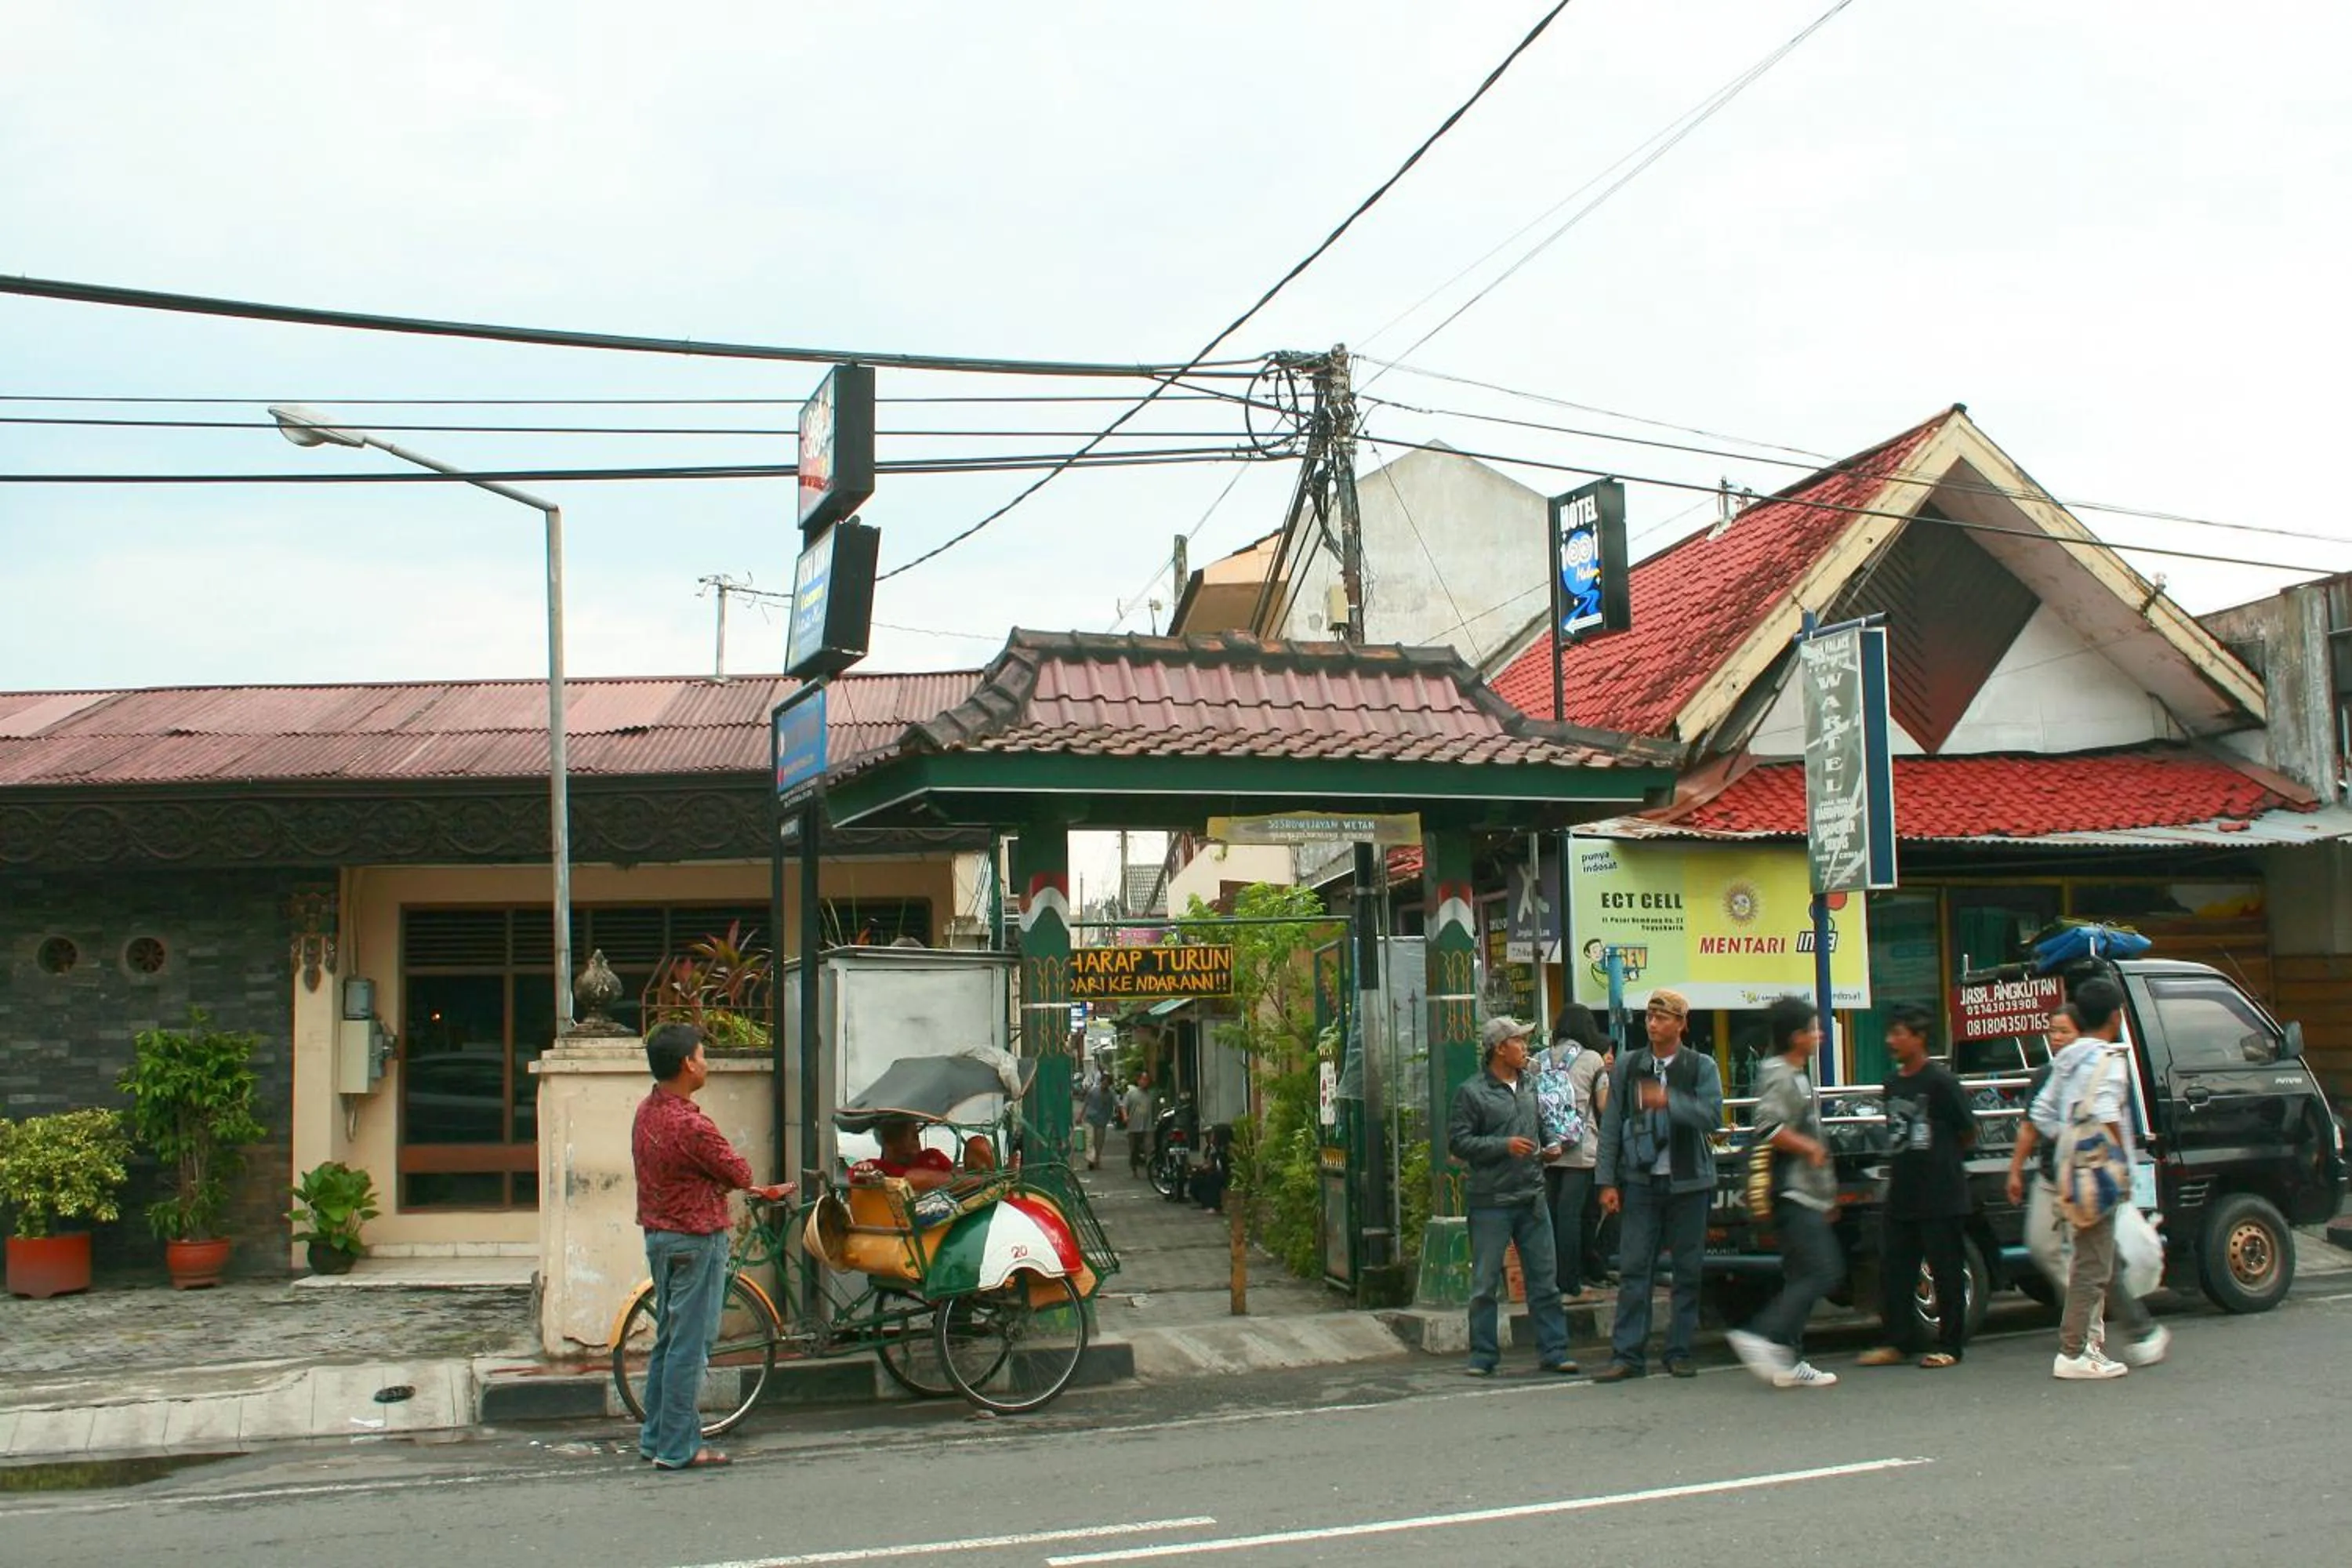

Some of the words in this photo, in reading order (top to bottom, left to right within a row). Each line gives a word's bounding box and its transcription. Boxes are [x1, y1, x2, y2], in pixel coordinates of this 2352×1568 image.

[1560, 494, 1598, 532] HOTEL
[1817, 672, 1843, 792] WARTEL
[1581, 851, 1610, 863] punya
[1583, 862, 1617, 873] indosat
[1601, 892, 1635, 909] ECT
[1641, 892, 1683, 909] CELL
[1700, 937, 1786, 954] MENTARI
[1152, 949, 1229, 971] TURUN
[1011, 1245, 1028, 1258] 20
